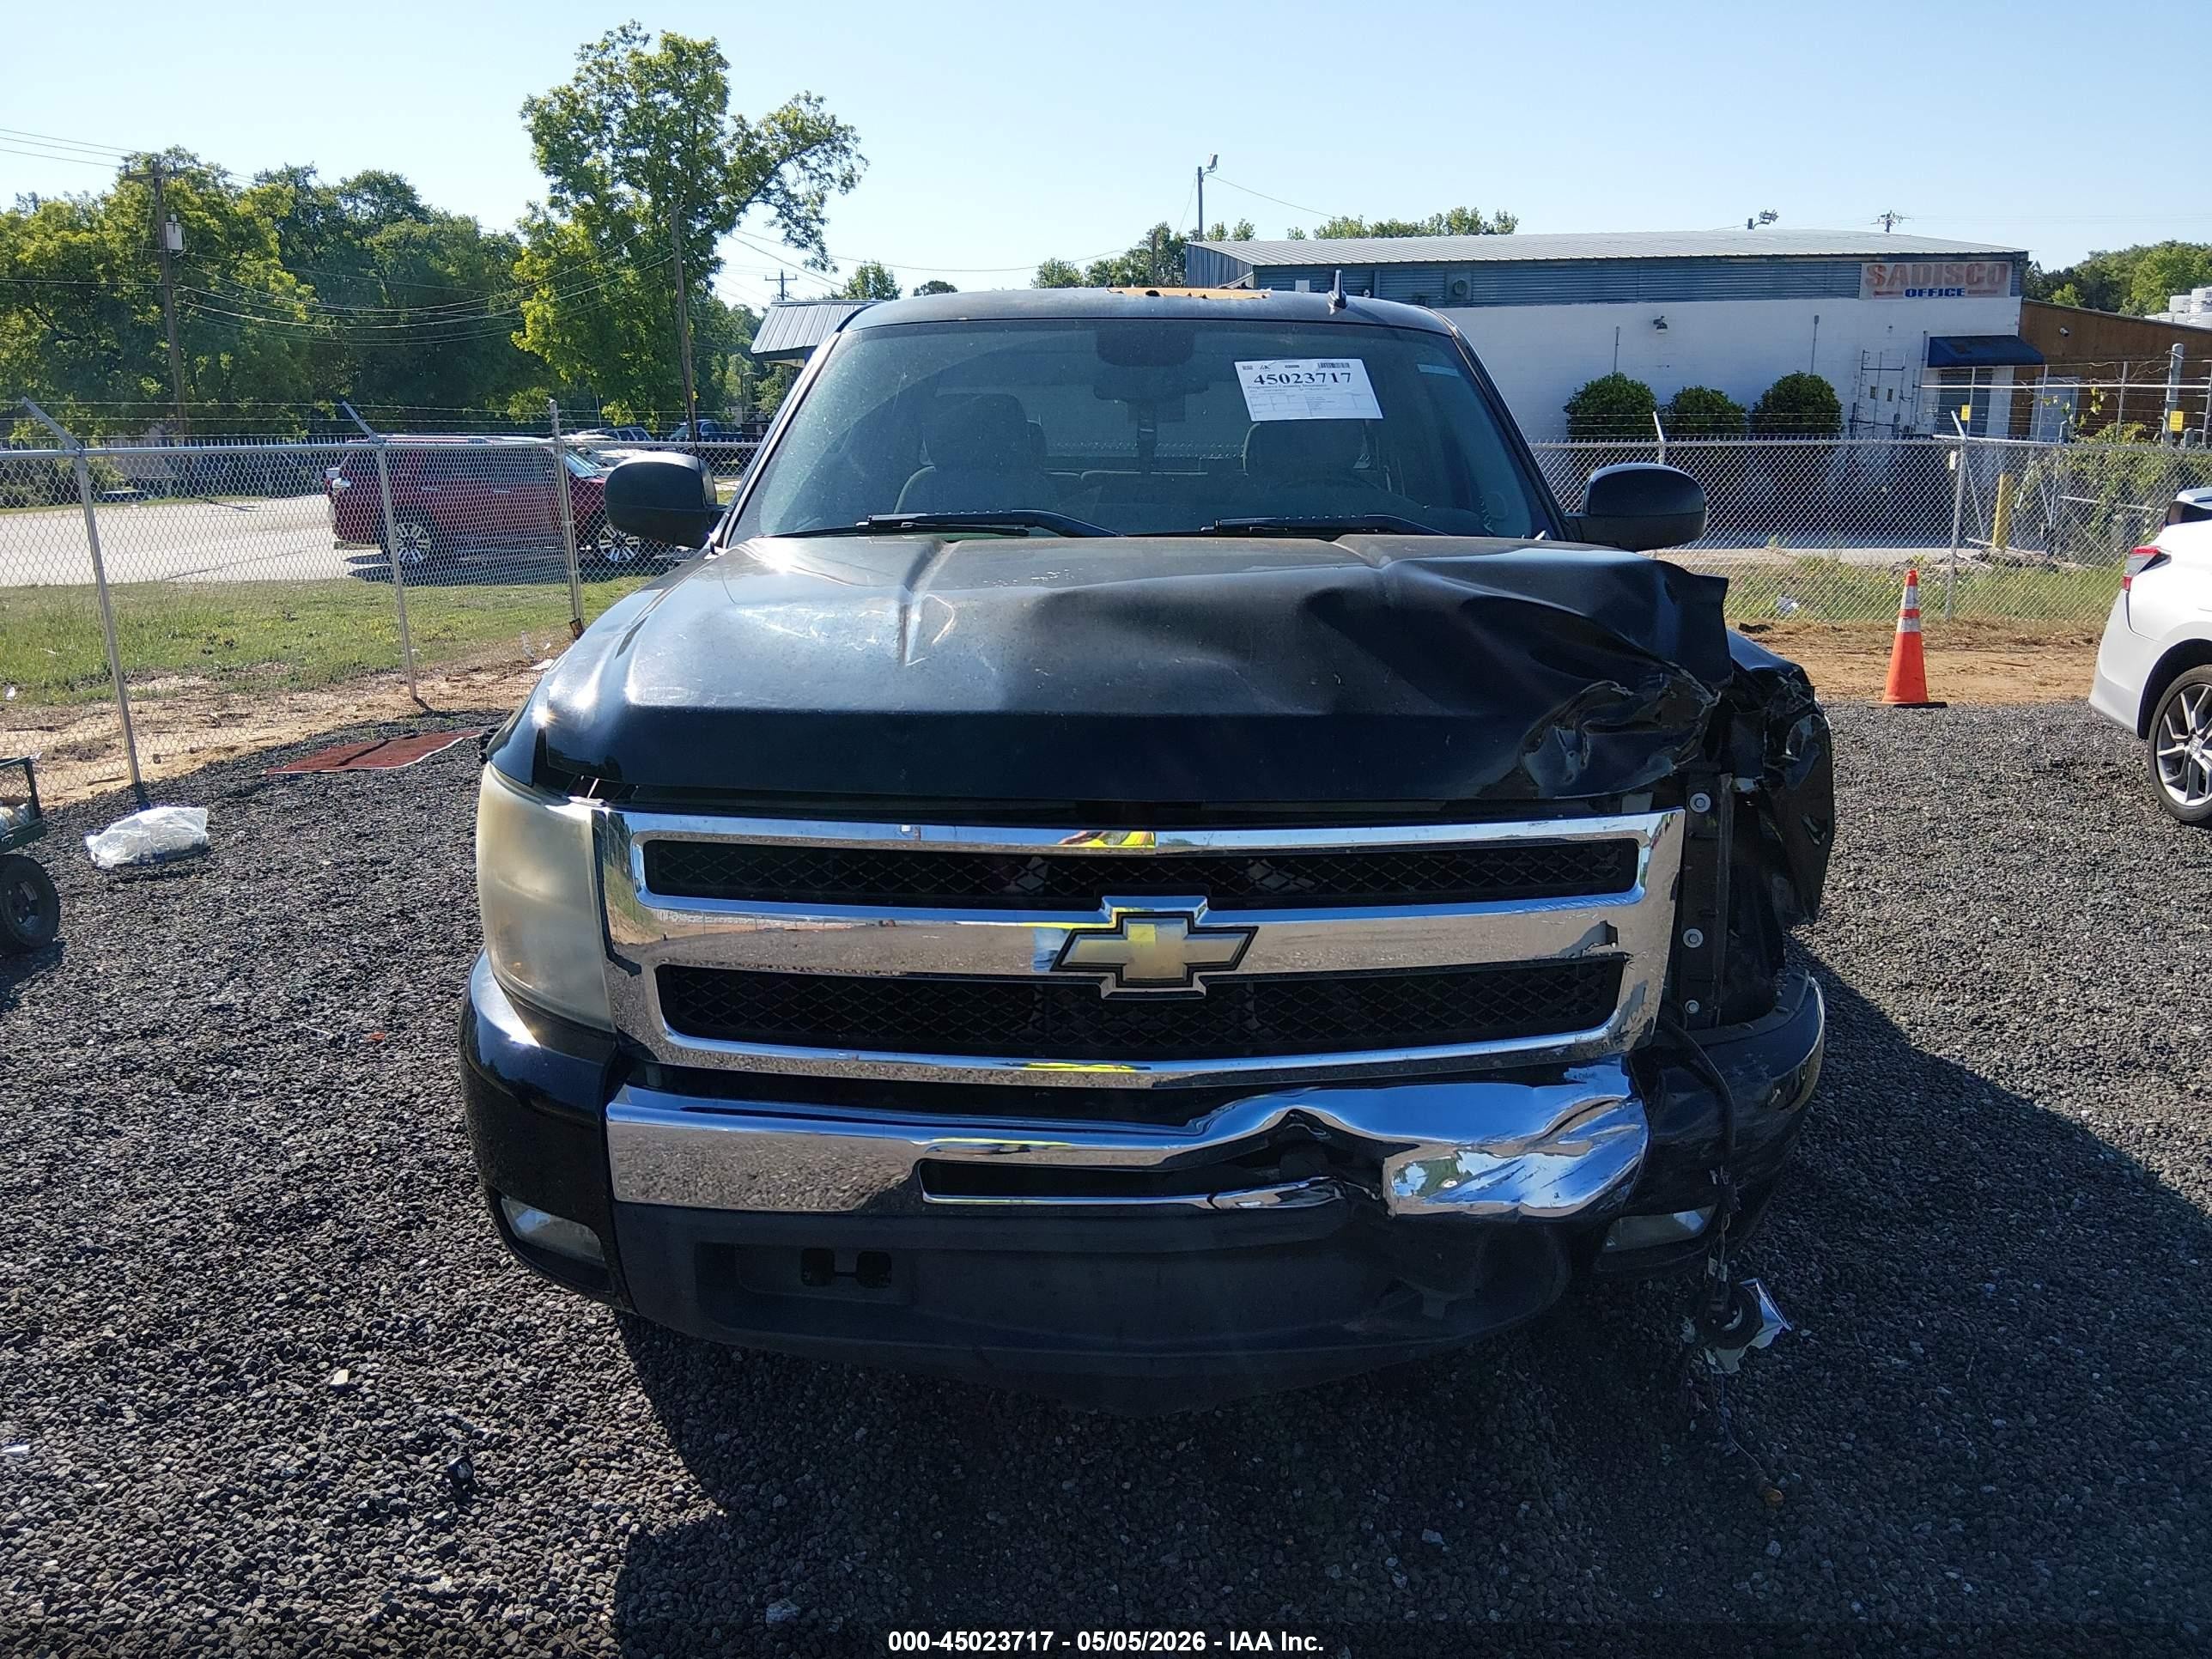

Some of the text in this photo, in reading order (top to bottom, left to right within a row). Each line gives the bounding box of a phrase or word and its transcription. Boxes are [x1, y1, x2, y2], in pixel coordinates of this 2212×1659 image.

[1865, 263, 2008, 287] SADISCO
[1905, 288, 1966, 298] OFFICE
[1254, 373, 1352, 385] 45023717
